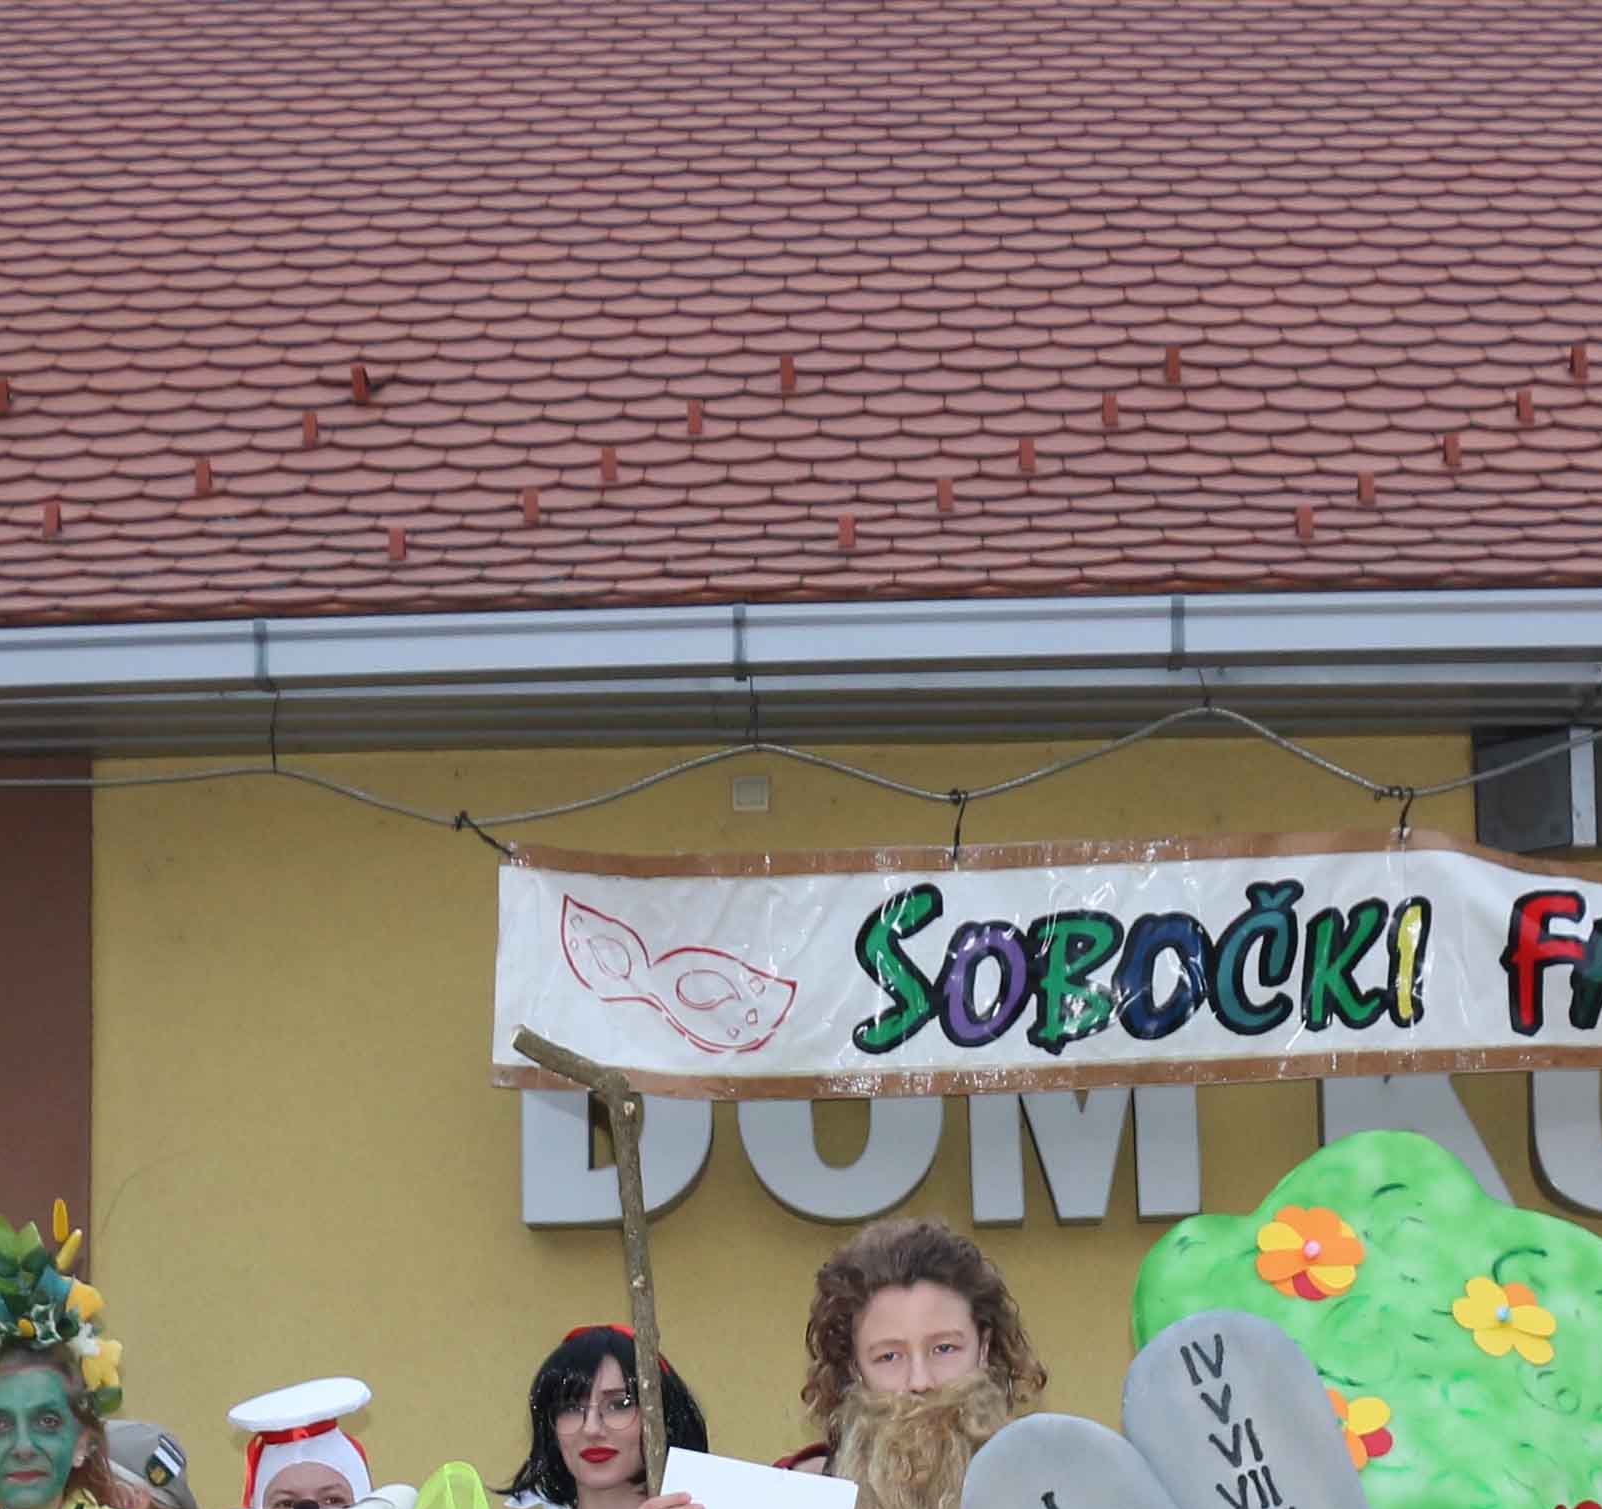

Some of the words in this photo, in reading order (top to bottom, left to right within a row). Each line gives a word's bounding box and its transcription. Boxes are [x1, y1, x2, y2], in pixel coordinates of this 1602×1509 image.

[852, 878, 1432, 1058] SOBOČKI
[1180, 1333, 1225, 1386] IV
[1200, 1383, 1232, 1425] V
[1208, 1417, 1264, 1468] VI
